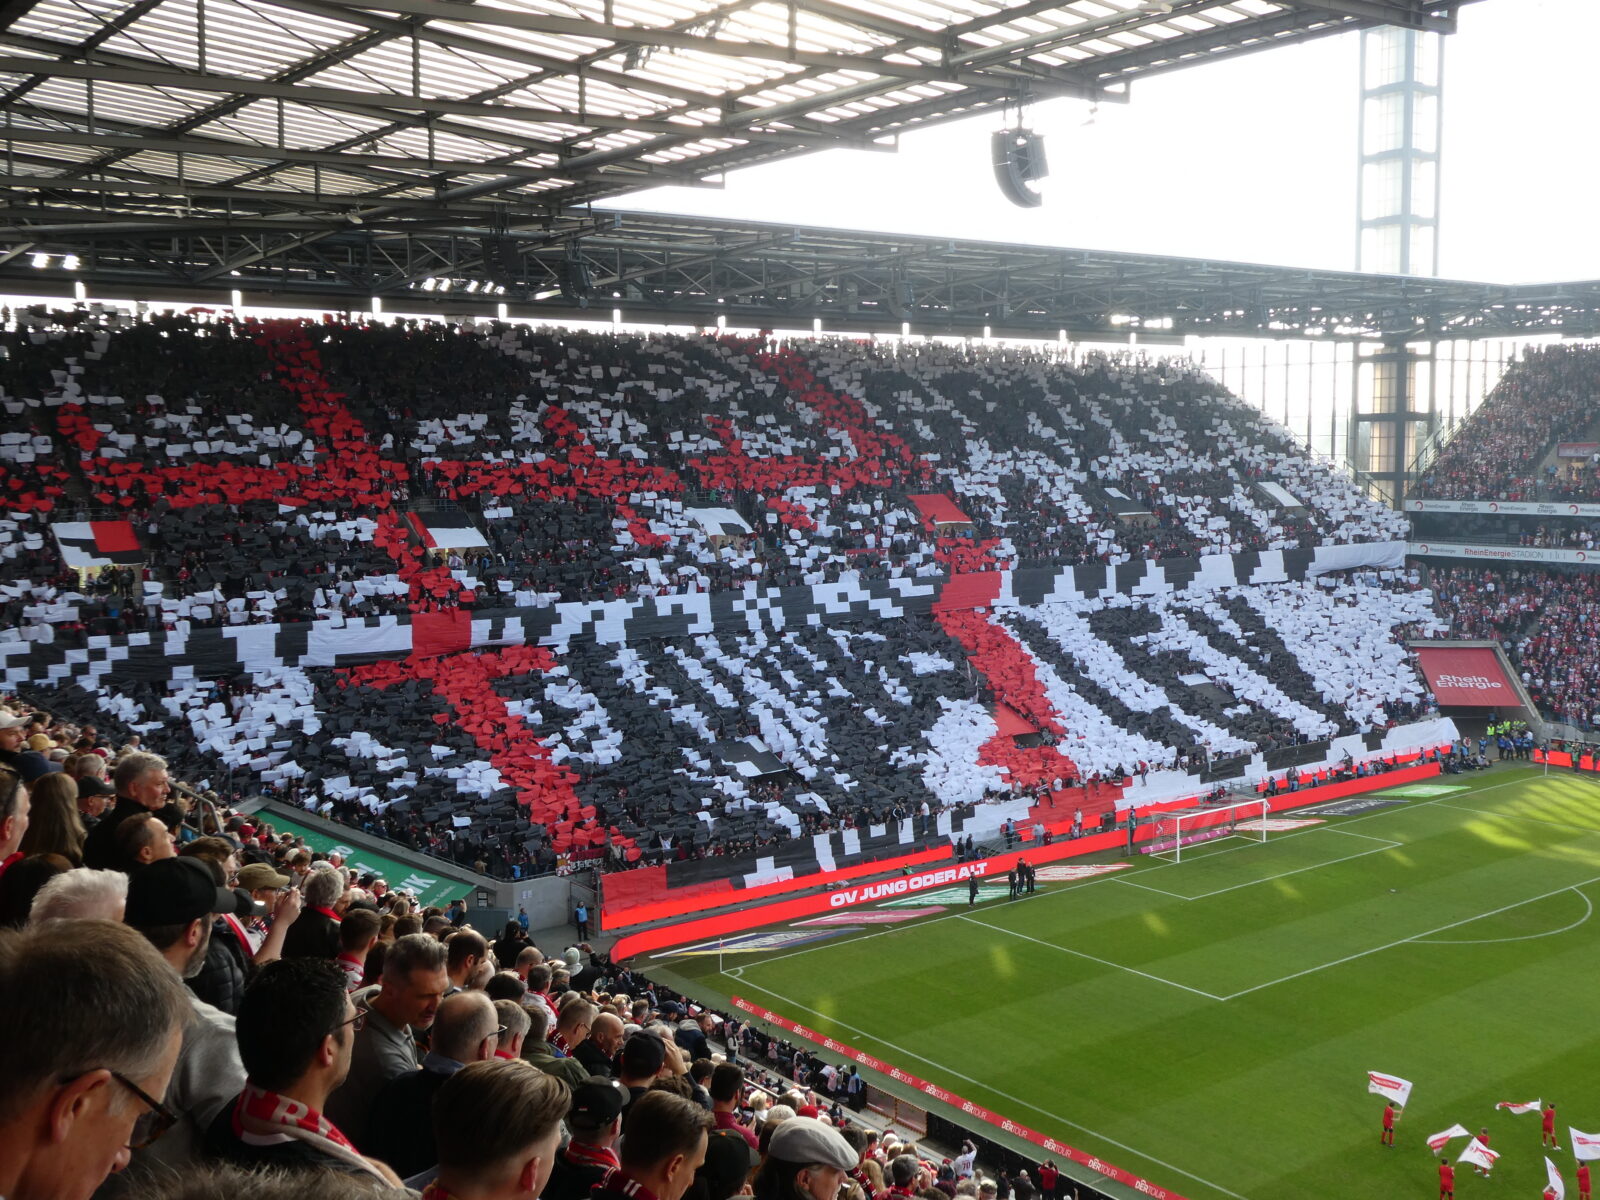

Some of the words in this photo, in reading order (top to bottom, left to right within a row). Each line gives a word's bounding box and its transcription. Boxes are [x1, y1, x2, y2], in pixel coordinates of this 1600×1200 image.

[1436, 680, 1502, 690] Energie
[1439, 674, 1488, 683] Rhein
[830, 889, 858, 907] OV
[859, 879, 908, 901] JUNG
[909, 868, 958, 890] ODER
[958, 862, 988, 879] ALT
[1001, 1120, 1028, 1138] DERTOUR
[1043, 1138, 1072, 1158] DERTOUR
[1088, 1158, 1118, 1179] DERTOUR
